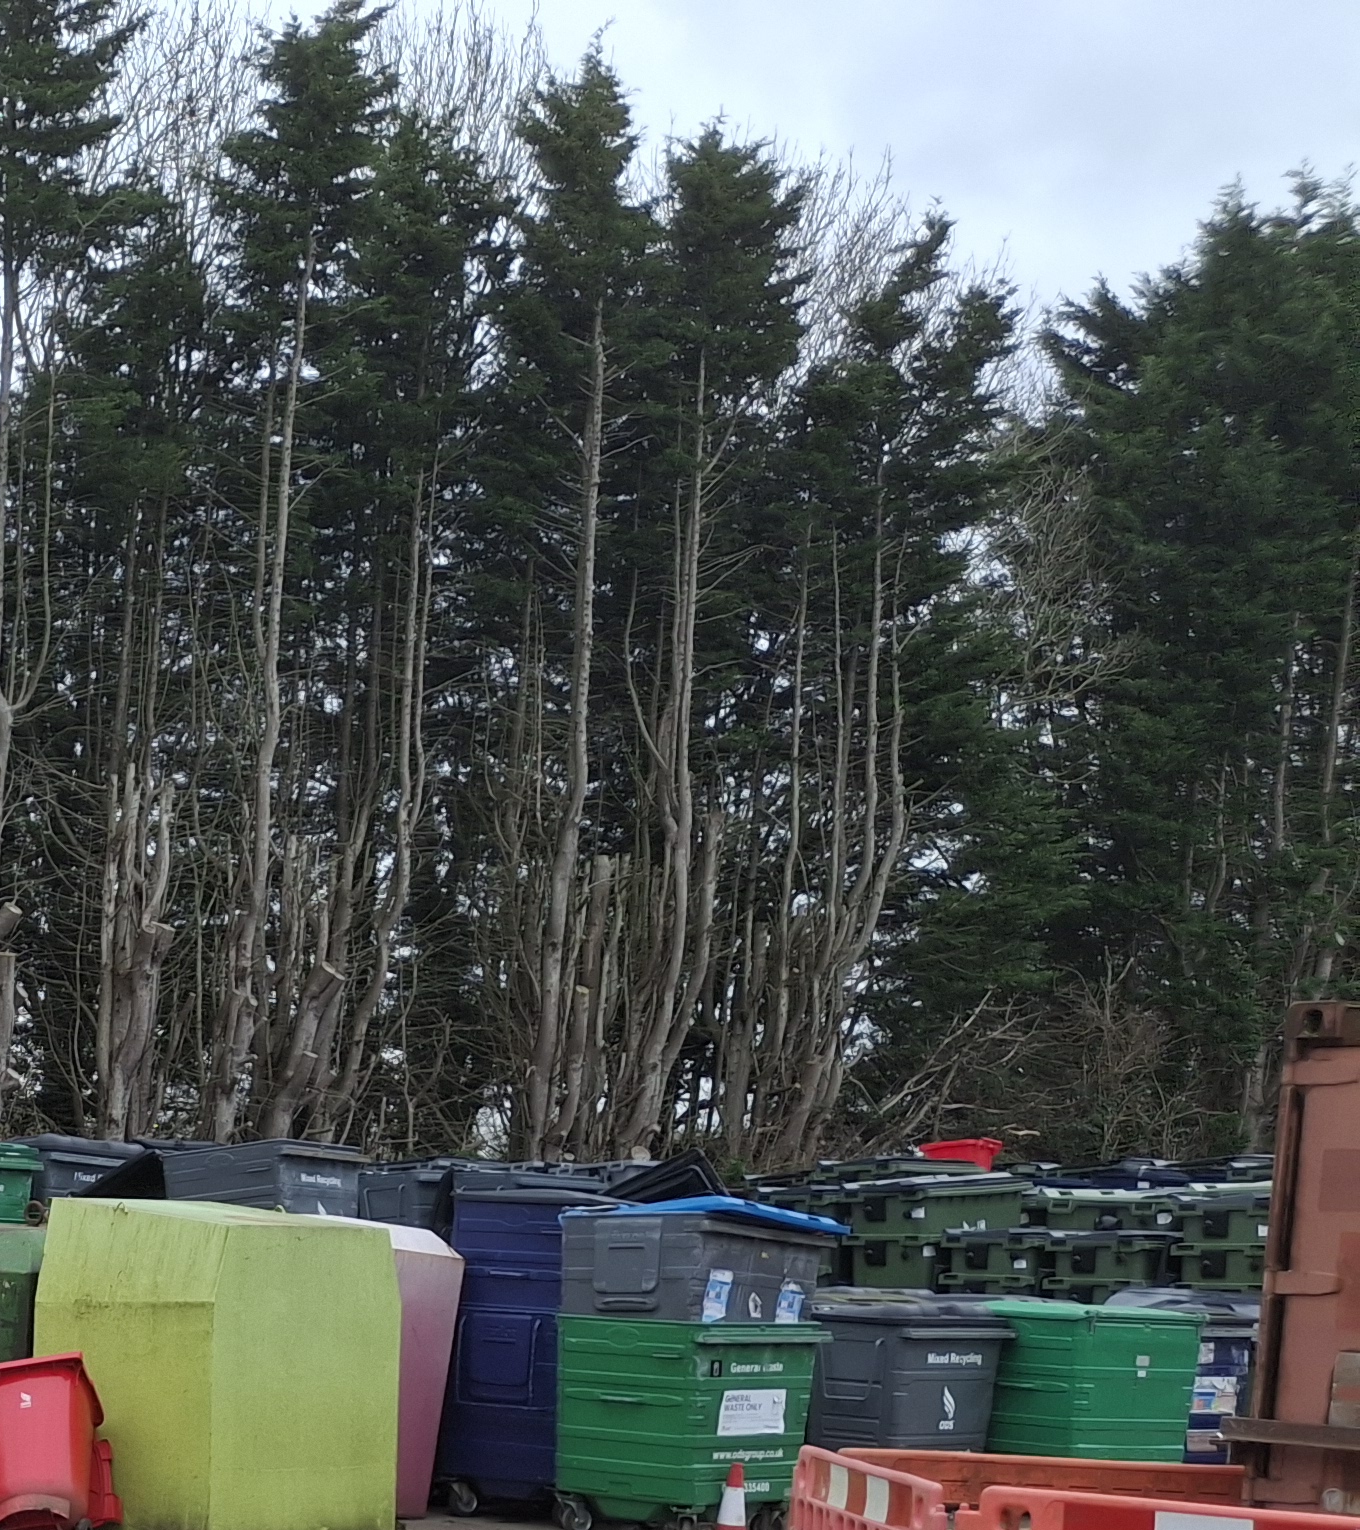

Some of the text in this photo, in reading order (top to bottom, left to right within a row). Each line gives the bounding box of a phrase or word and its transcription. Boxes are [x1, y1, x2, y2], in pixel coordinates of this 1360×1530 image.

[927, 1352, 983, 1366] Mixed Recycling
[725, 1394, 752, 1403] GENERAL
[724, 1403, 763, 1412] WASTE ONLY
